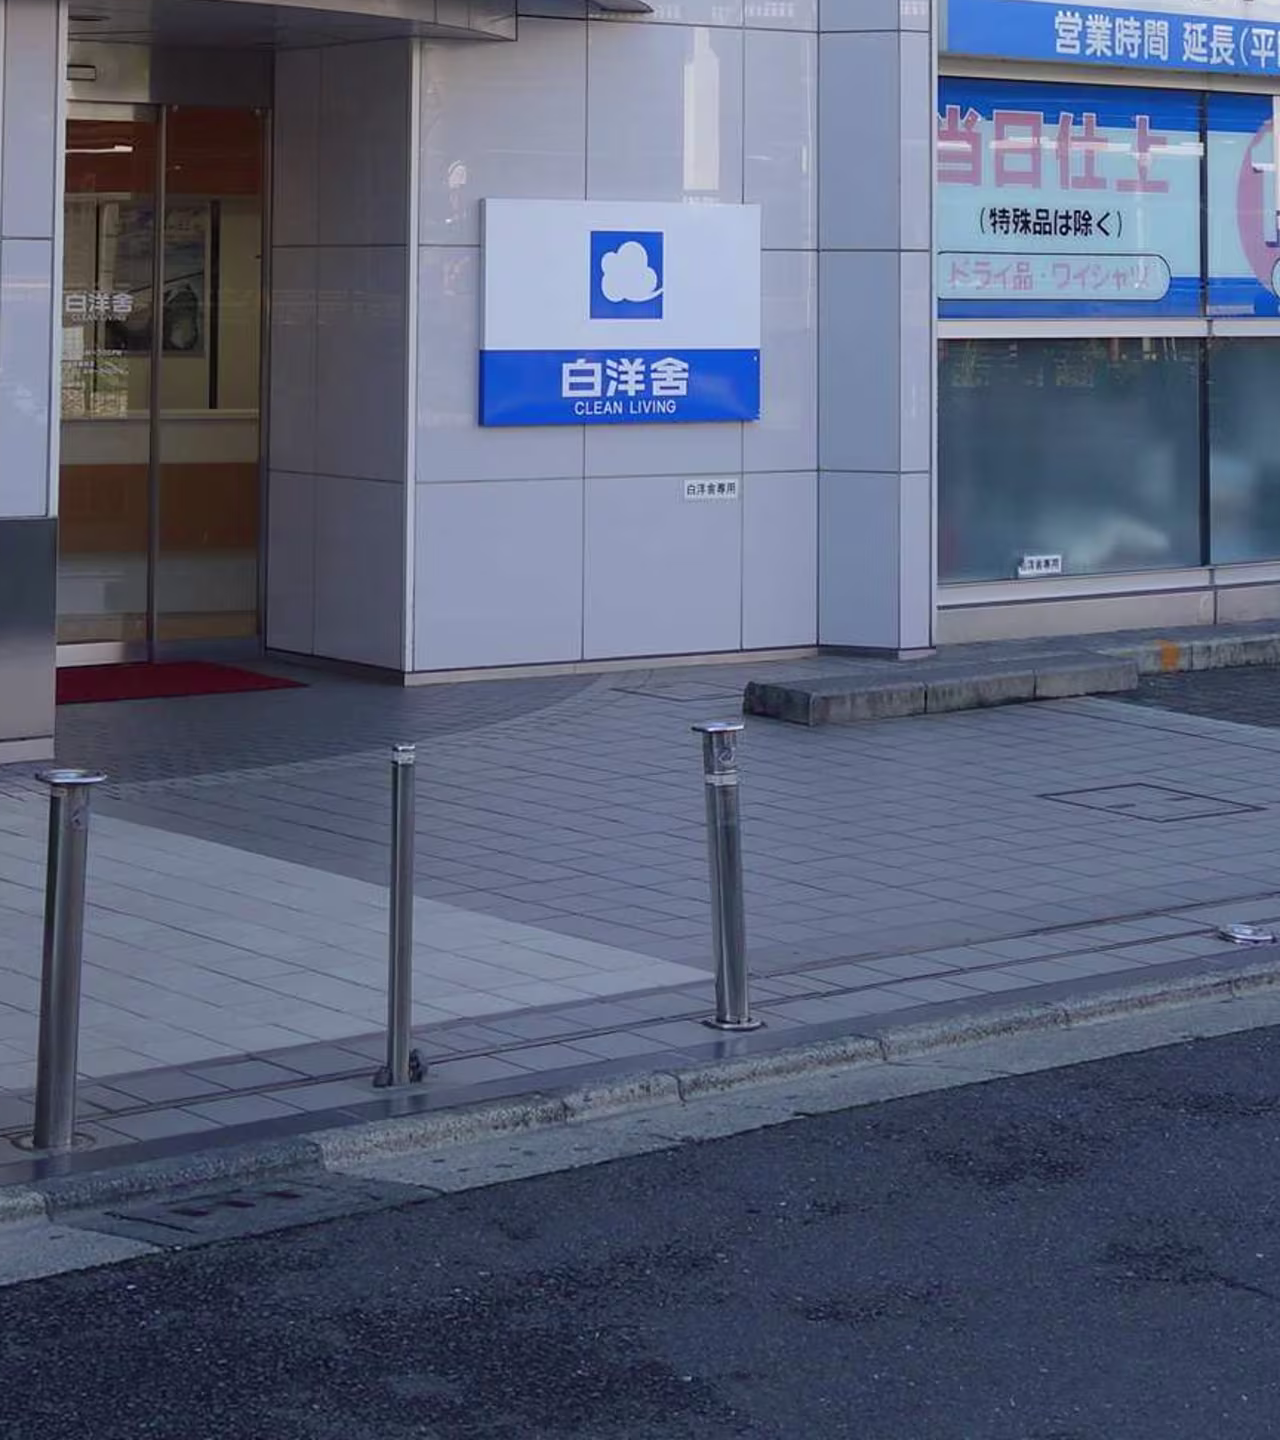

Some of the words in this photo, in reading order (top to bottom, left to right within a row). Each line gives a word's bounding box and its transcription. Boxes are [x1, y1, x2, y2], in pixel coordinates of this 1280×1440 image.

[1054, 10, 1170, 63] 営業時間
[66, 292, 134, 313] 白洋舎
[561, 356, 690, 398] 白洋舎
[574, 400, 624, 416] CLEAN
[629, 399, 677, 415] LIVING
